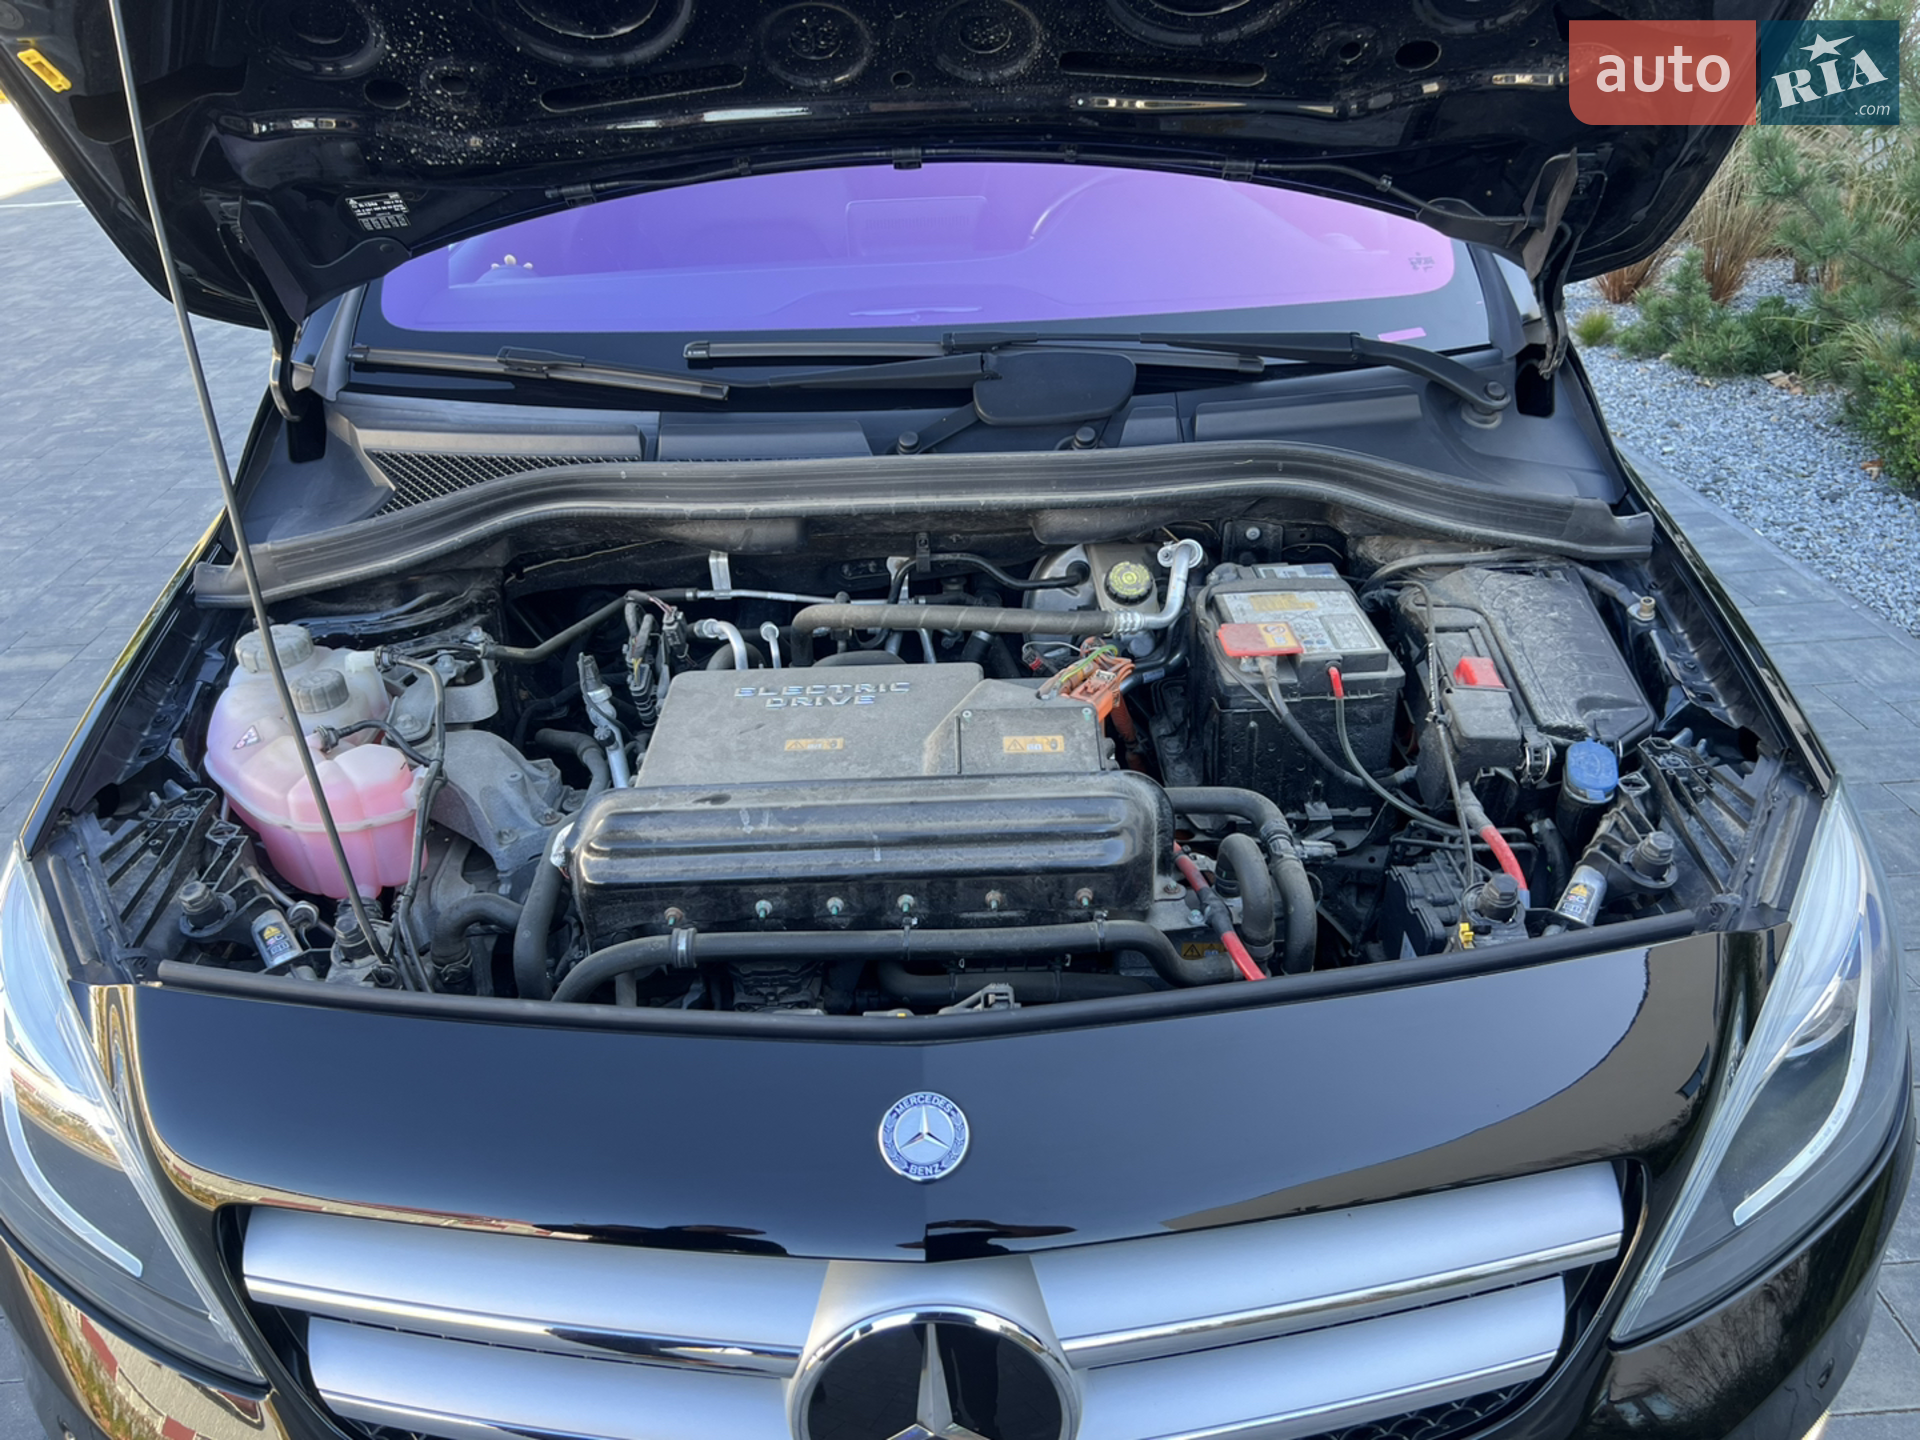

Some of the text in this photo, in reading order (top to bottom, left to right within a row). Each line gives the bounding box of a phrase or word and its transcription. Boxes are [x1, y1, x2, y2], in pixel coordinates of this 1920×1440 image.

[734, 682, 910, 697] ELECTRIC
[765, 695, 876, 708] DRIVE
[894, 1095, 953, 1115] MERCEDES
[908, 1163, 942, 1176] BENZ
